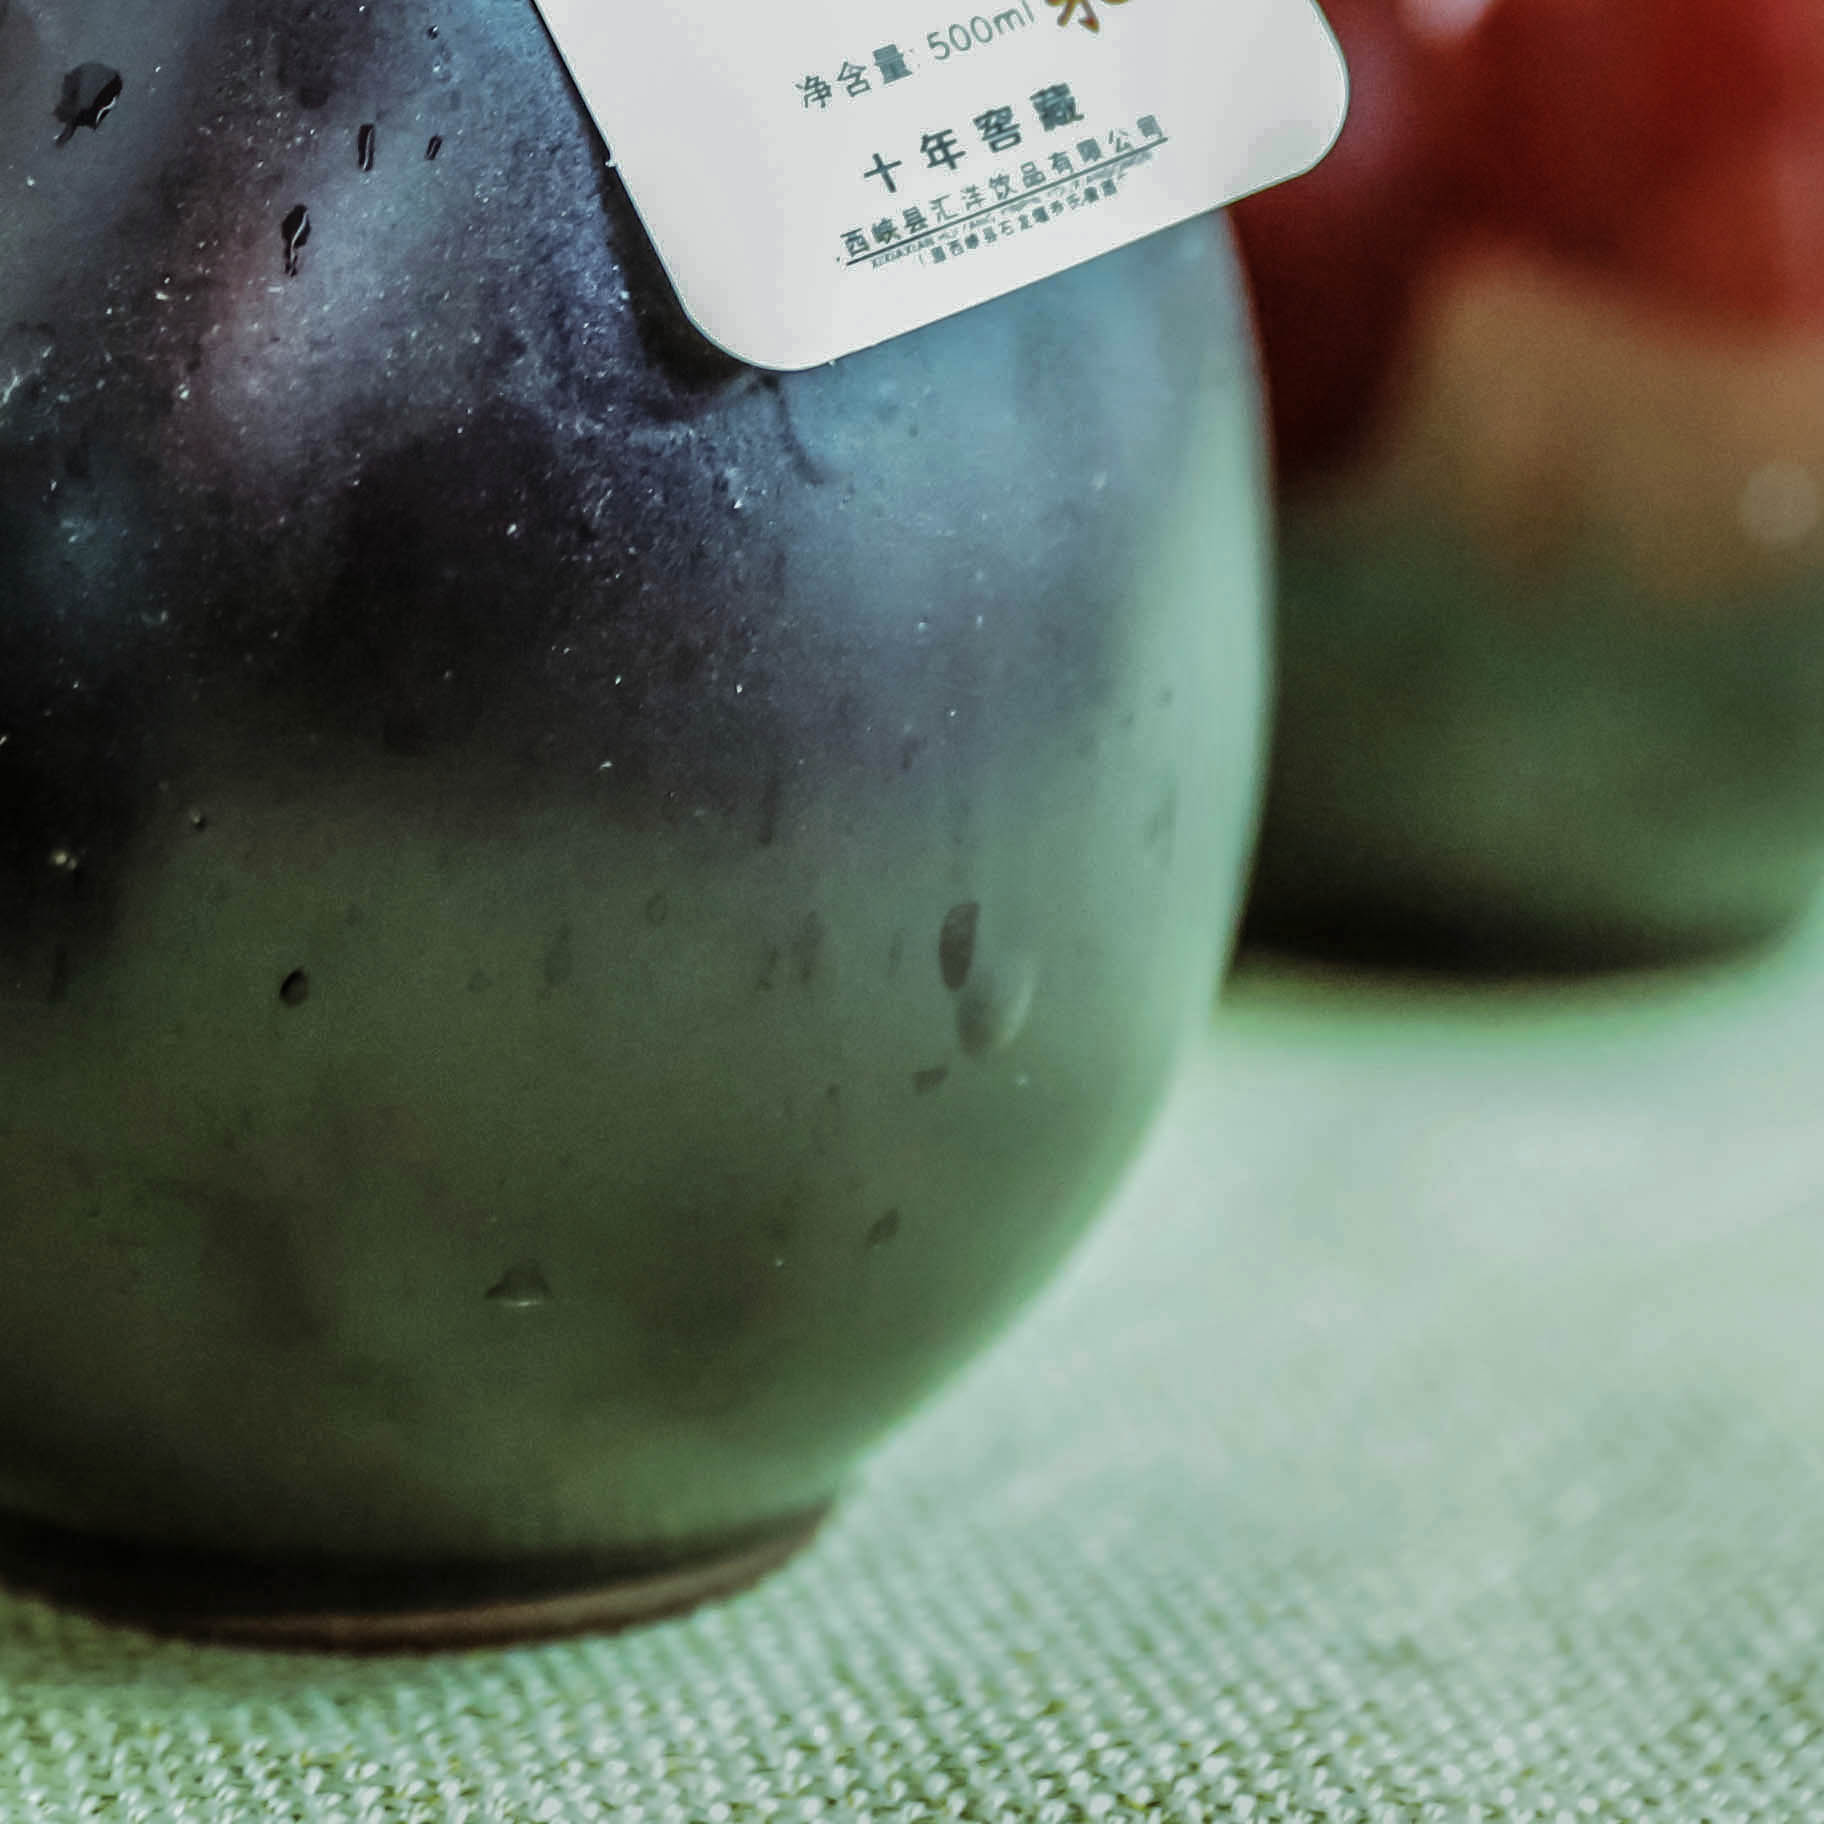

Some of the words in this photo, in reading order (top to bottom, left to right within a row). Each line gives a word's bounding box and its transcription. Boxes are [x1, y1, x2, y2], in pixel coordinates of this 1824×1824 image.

[926, 0, 1035, 61] 500ml
[863, 83, 1085, 194] 十年窖藏
